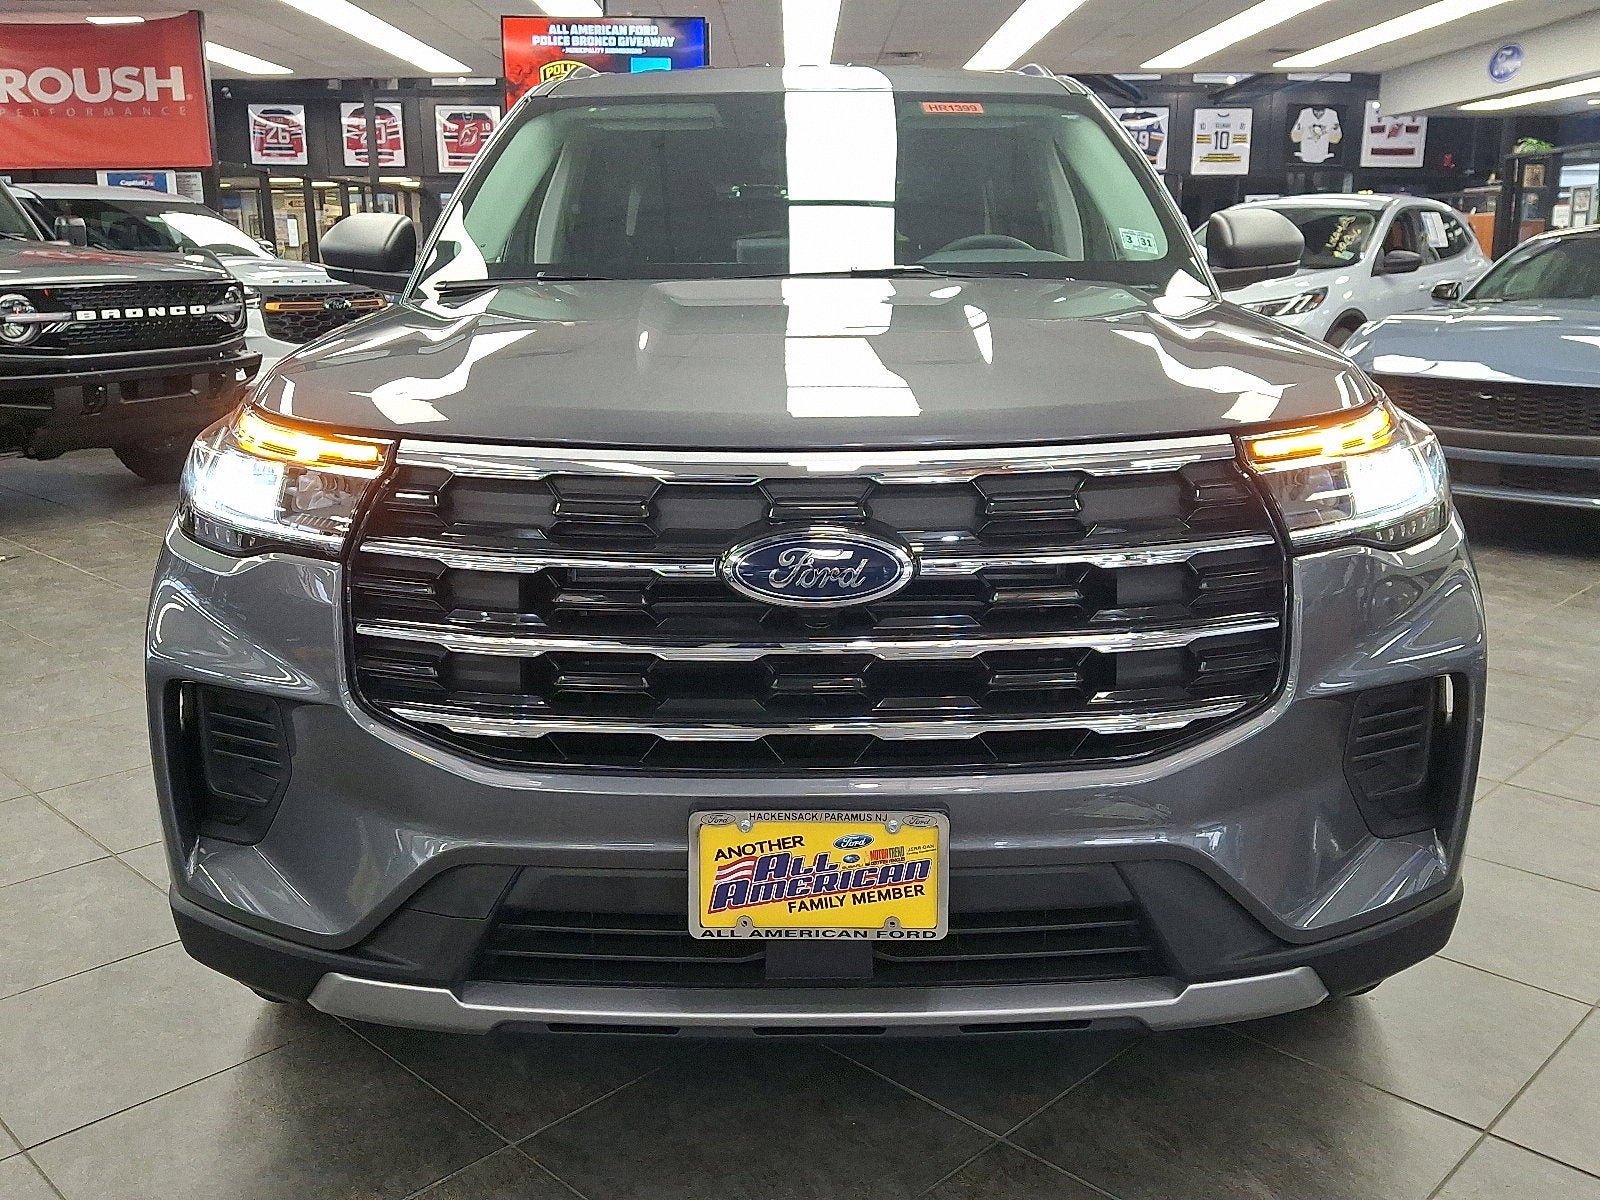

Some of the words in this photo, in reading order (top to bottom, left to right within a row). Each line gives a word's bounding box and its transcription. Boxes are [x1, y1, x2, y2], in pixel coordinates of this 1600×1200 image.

[548, 24, 569, 35] ALL
[571, 24, 628, 36] AMERICAN
[629, 25, 658, 35] FORD
[532, 36, 570, 47] POLICE
[571, 36, 616, 47] BRONCO
[618, 36, 676, 48] GIVEAWAY
[545, 63, 577, 79] POLI
[0, 66, 186, 104] ROUSH
[0, 106, 188, 117] PERFORMANCE
[928, 104, 978, 112] HR1399
[266, 126, 290, 144] 26
[1214, 131, 1230, 150] 10
[1126, 235, 1133, 243] 3
[1140, 237, 1152, 247] 31
[76, 305, 206, 320] BRONCO
[768, 547, 869, 589] Ford
[707, 814, 729, 824] Ford
[749, 812, 872, 822] HACKENSACK/PARAMUS
[875, 813, 888, 822] NJ
[908, 815, 931, 825] Ford
[714, 835, 805, 861] ANOTHER
[788, 894, 846, 913] FAMILY
[852, 884, 926, 905] MEMBER
[700, 929, 740, 938] ALL
[749, 929, 868, 938] AMERICAN
[876, 930, 937, 939] FORD
